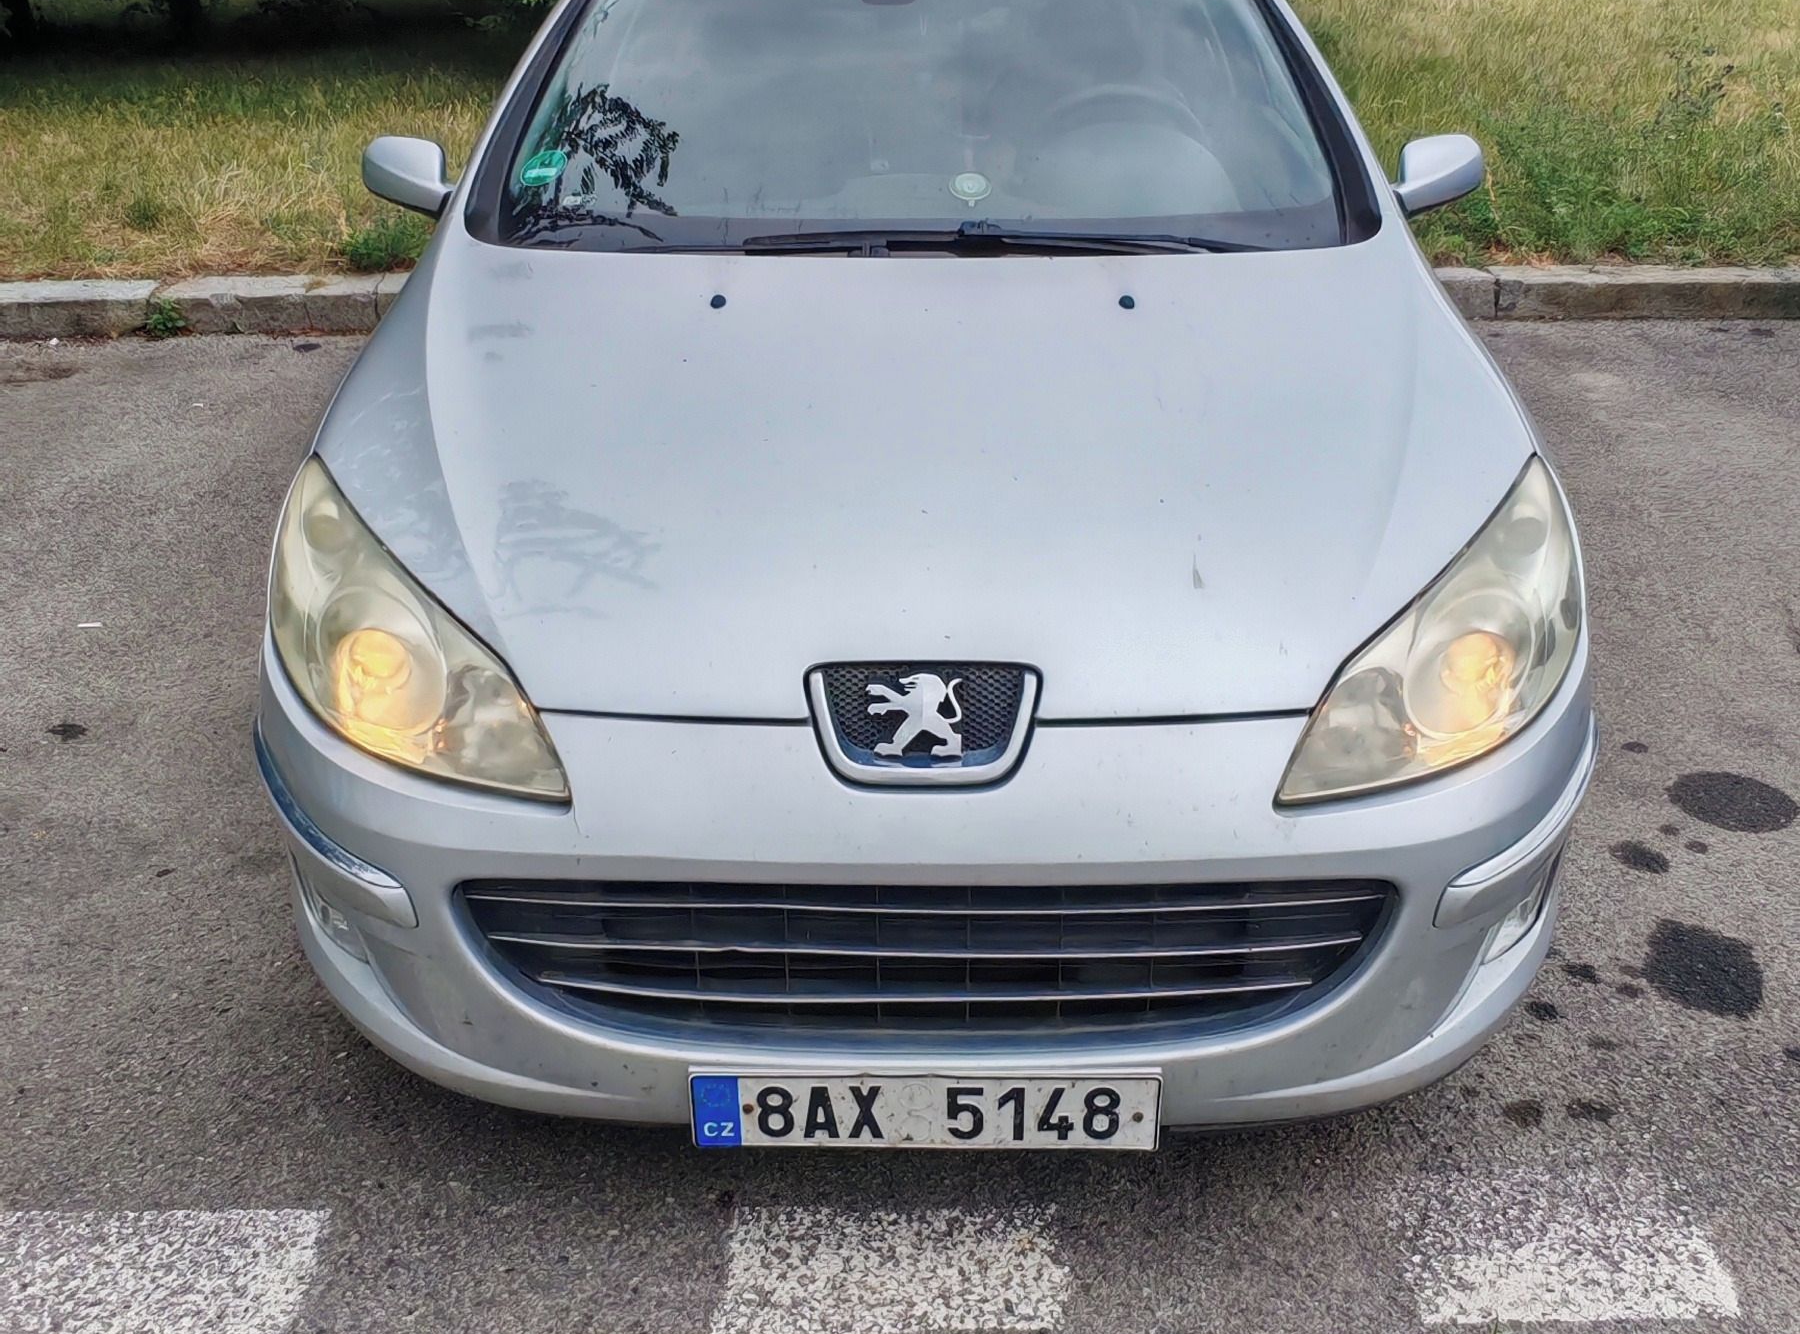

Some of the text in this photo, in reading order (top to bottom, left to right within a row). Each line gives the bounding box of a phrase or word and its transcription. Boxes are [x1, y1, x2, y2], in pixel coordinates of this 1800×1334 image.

[703, 1121, 735, 1137] CZ
[756, 1086, 1121, 1141] 8AX 5148
